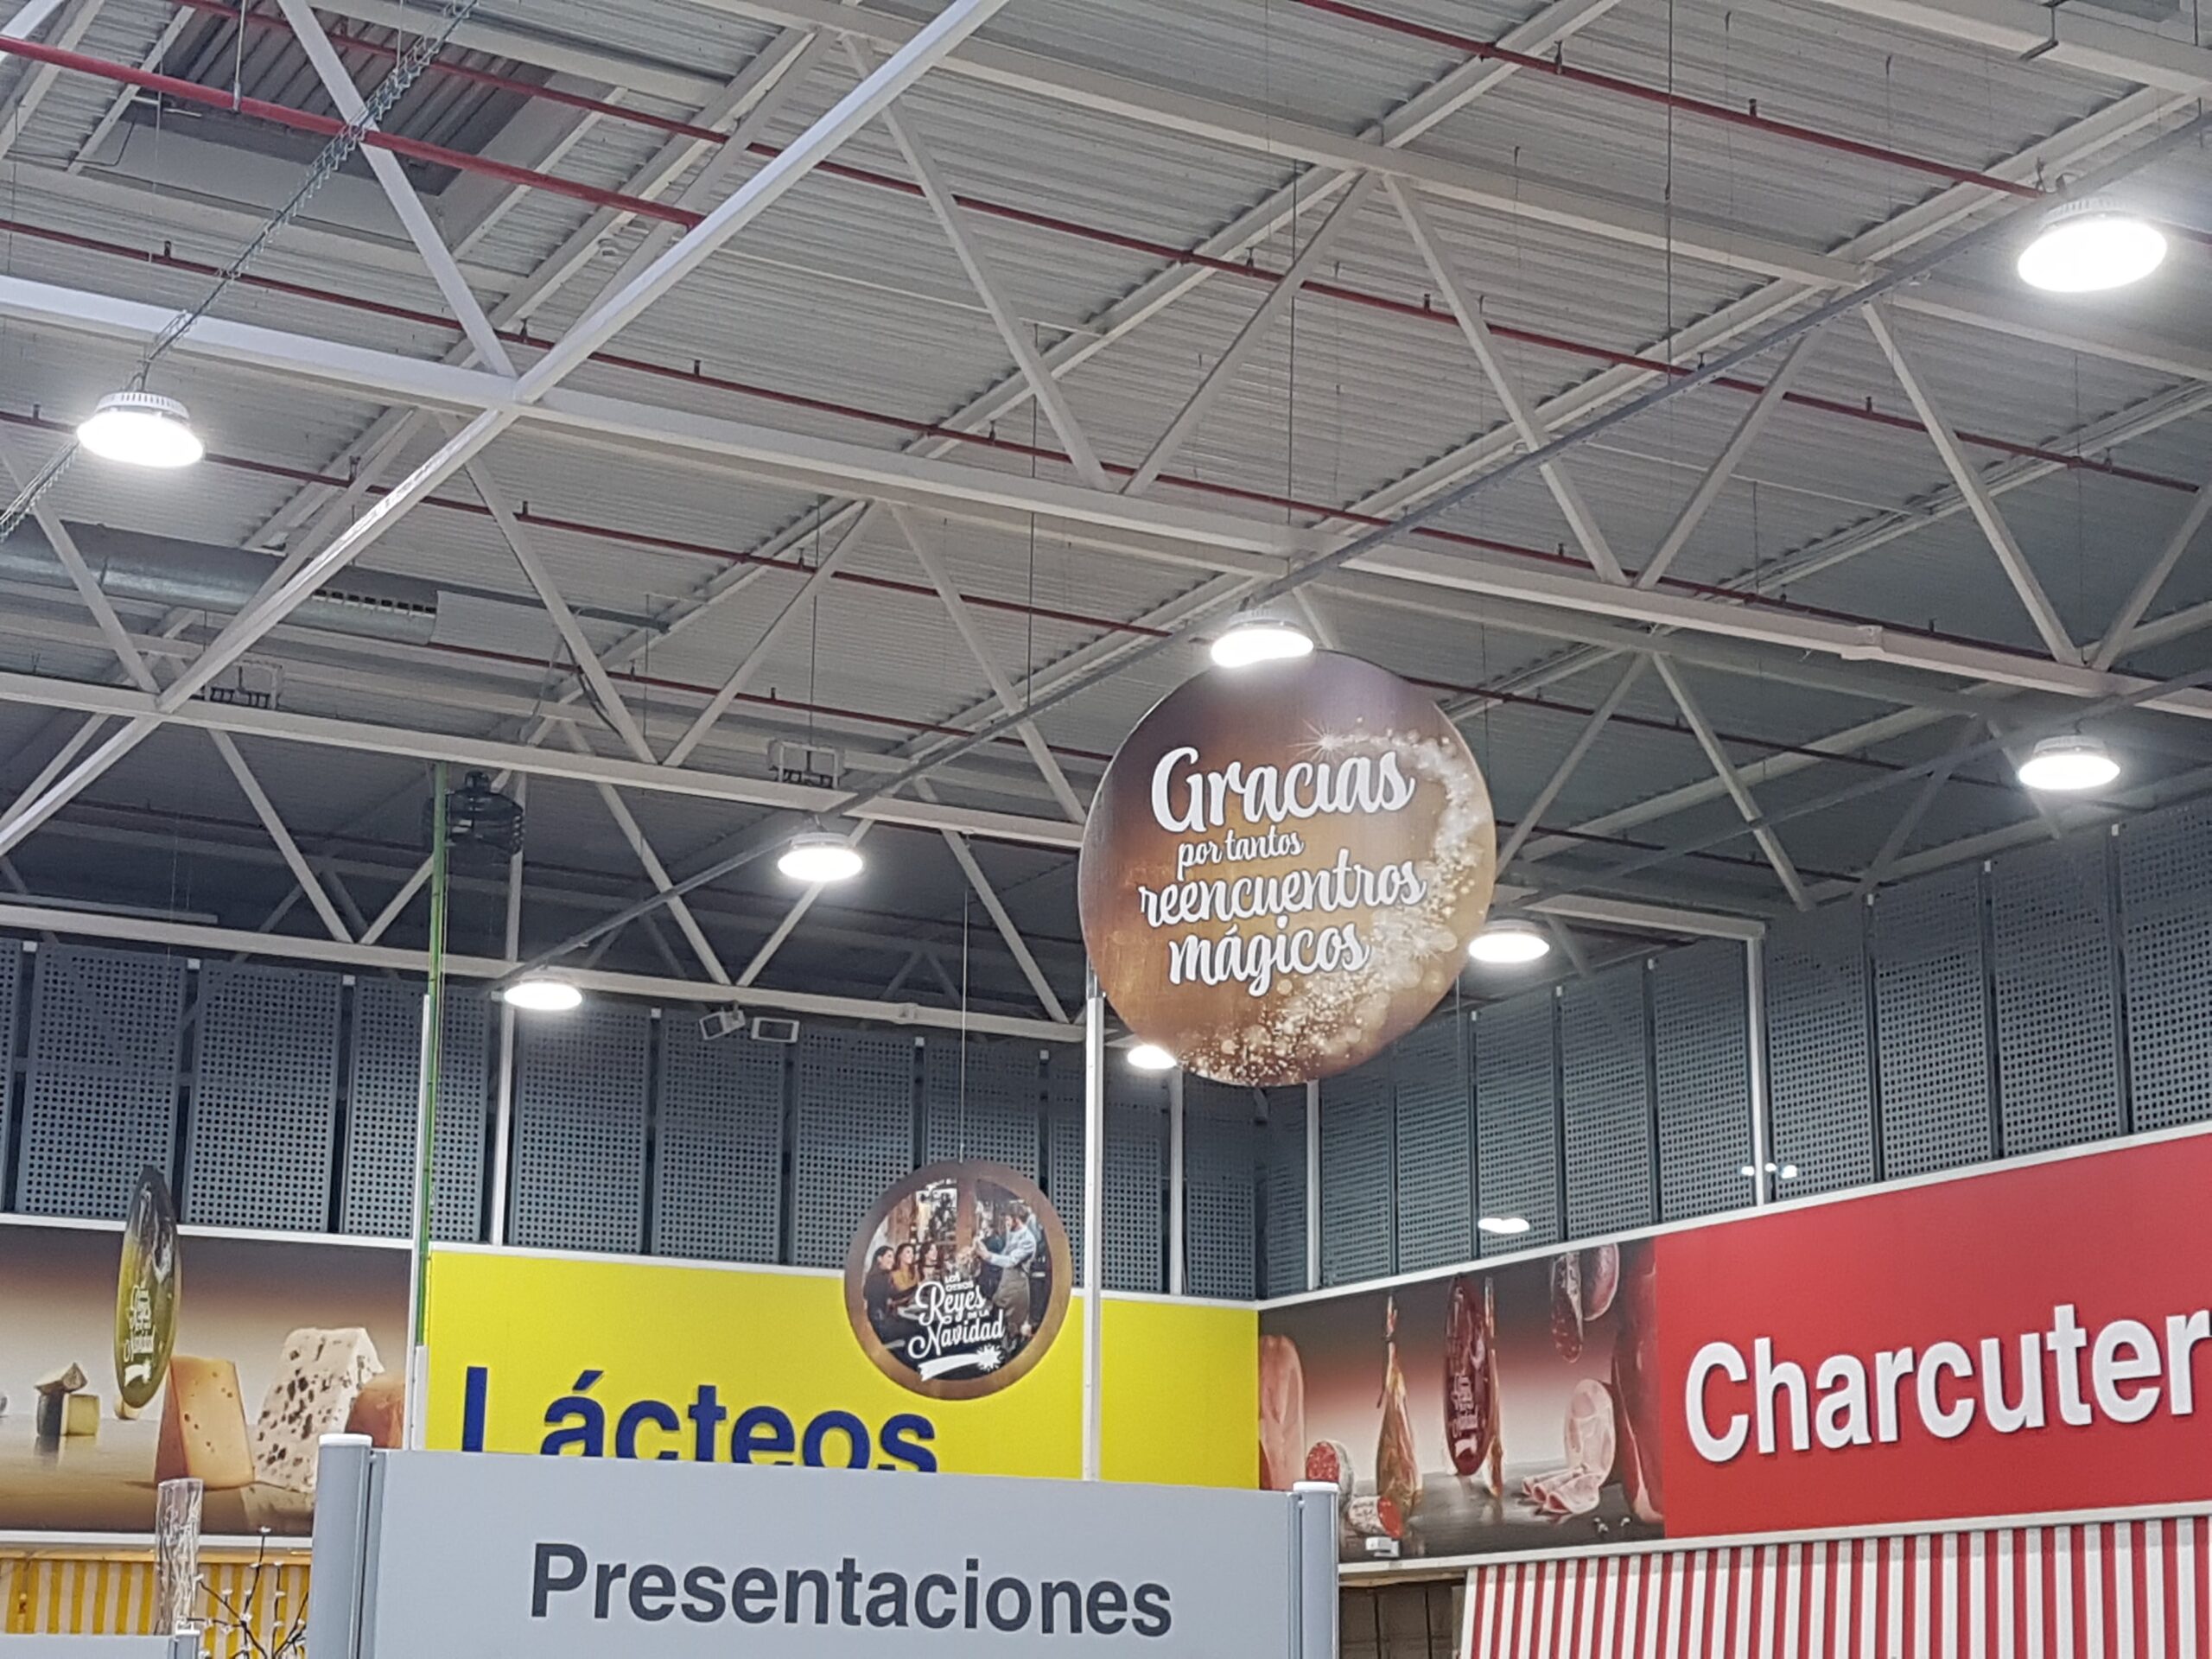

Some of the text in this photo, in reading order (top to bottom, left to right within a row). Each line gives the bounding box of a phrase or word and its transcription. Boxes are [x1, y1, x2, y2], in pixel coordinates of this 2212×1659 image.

[1151, 746, 1415, 832] Gracias
[1138, 849, 1427, 928] reencuentros
[1177, 824, 1305, 881] por tantos
[1169, 915, 1371, 997] mágicos
[907, 1308, 1005, 1359] Navidad
[915, 1281, 986, 1326] Reyes
[1685, 1304, 2212, 1463] Charcuter
[531, 1542, 1173, 1638] Presentaciones
